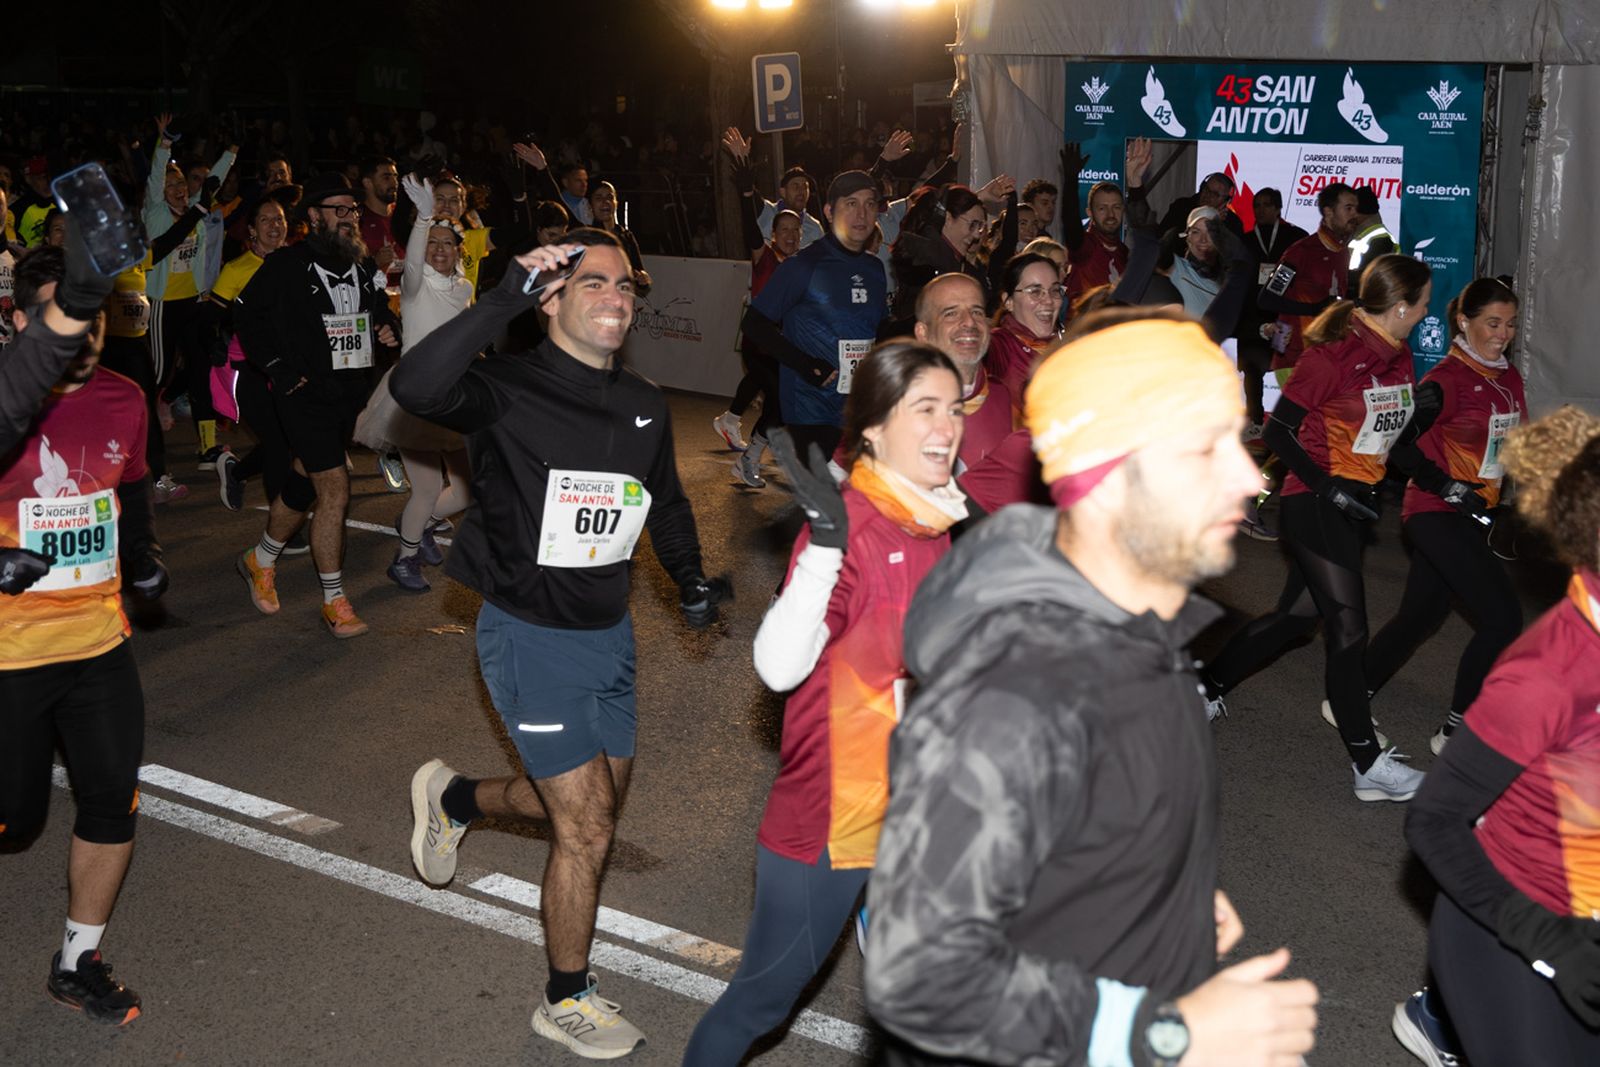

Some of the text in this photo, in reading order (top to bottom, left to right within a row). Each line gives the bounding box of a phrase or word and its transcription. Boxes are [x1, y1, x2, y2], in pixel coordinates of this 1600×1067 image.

[765, 64, 792, 122] P
[1153, 105, 1172, 125] 43
[1206, 100, 1309, 134] ANTÓN
[1352, 109, 1372, 130] 43
[1418, 112, 1437, 120] CAJA
[1431, 120, 1452, 128] JAÉN
[1304, 154, 1337, 162] CARRERA
[1338, 155, 1369, 163] URBANA
[1301, 165, 1348, 175] NOCHE DE
[1406, 183, 1471, 197] calderón
[330, 334, 362, 351] 2188
[1373, 409, 1406, 432] 6633
[573, 483, 615, 494] NOCHE DE
[559, 493, 580, 503] SAN
[45, 505, 89, 517] NOCHE DE
[33, 520, 54, 530] SAN
[575, 507, 622, 535] 607
[41, 525, 106, 558] 8099
